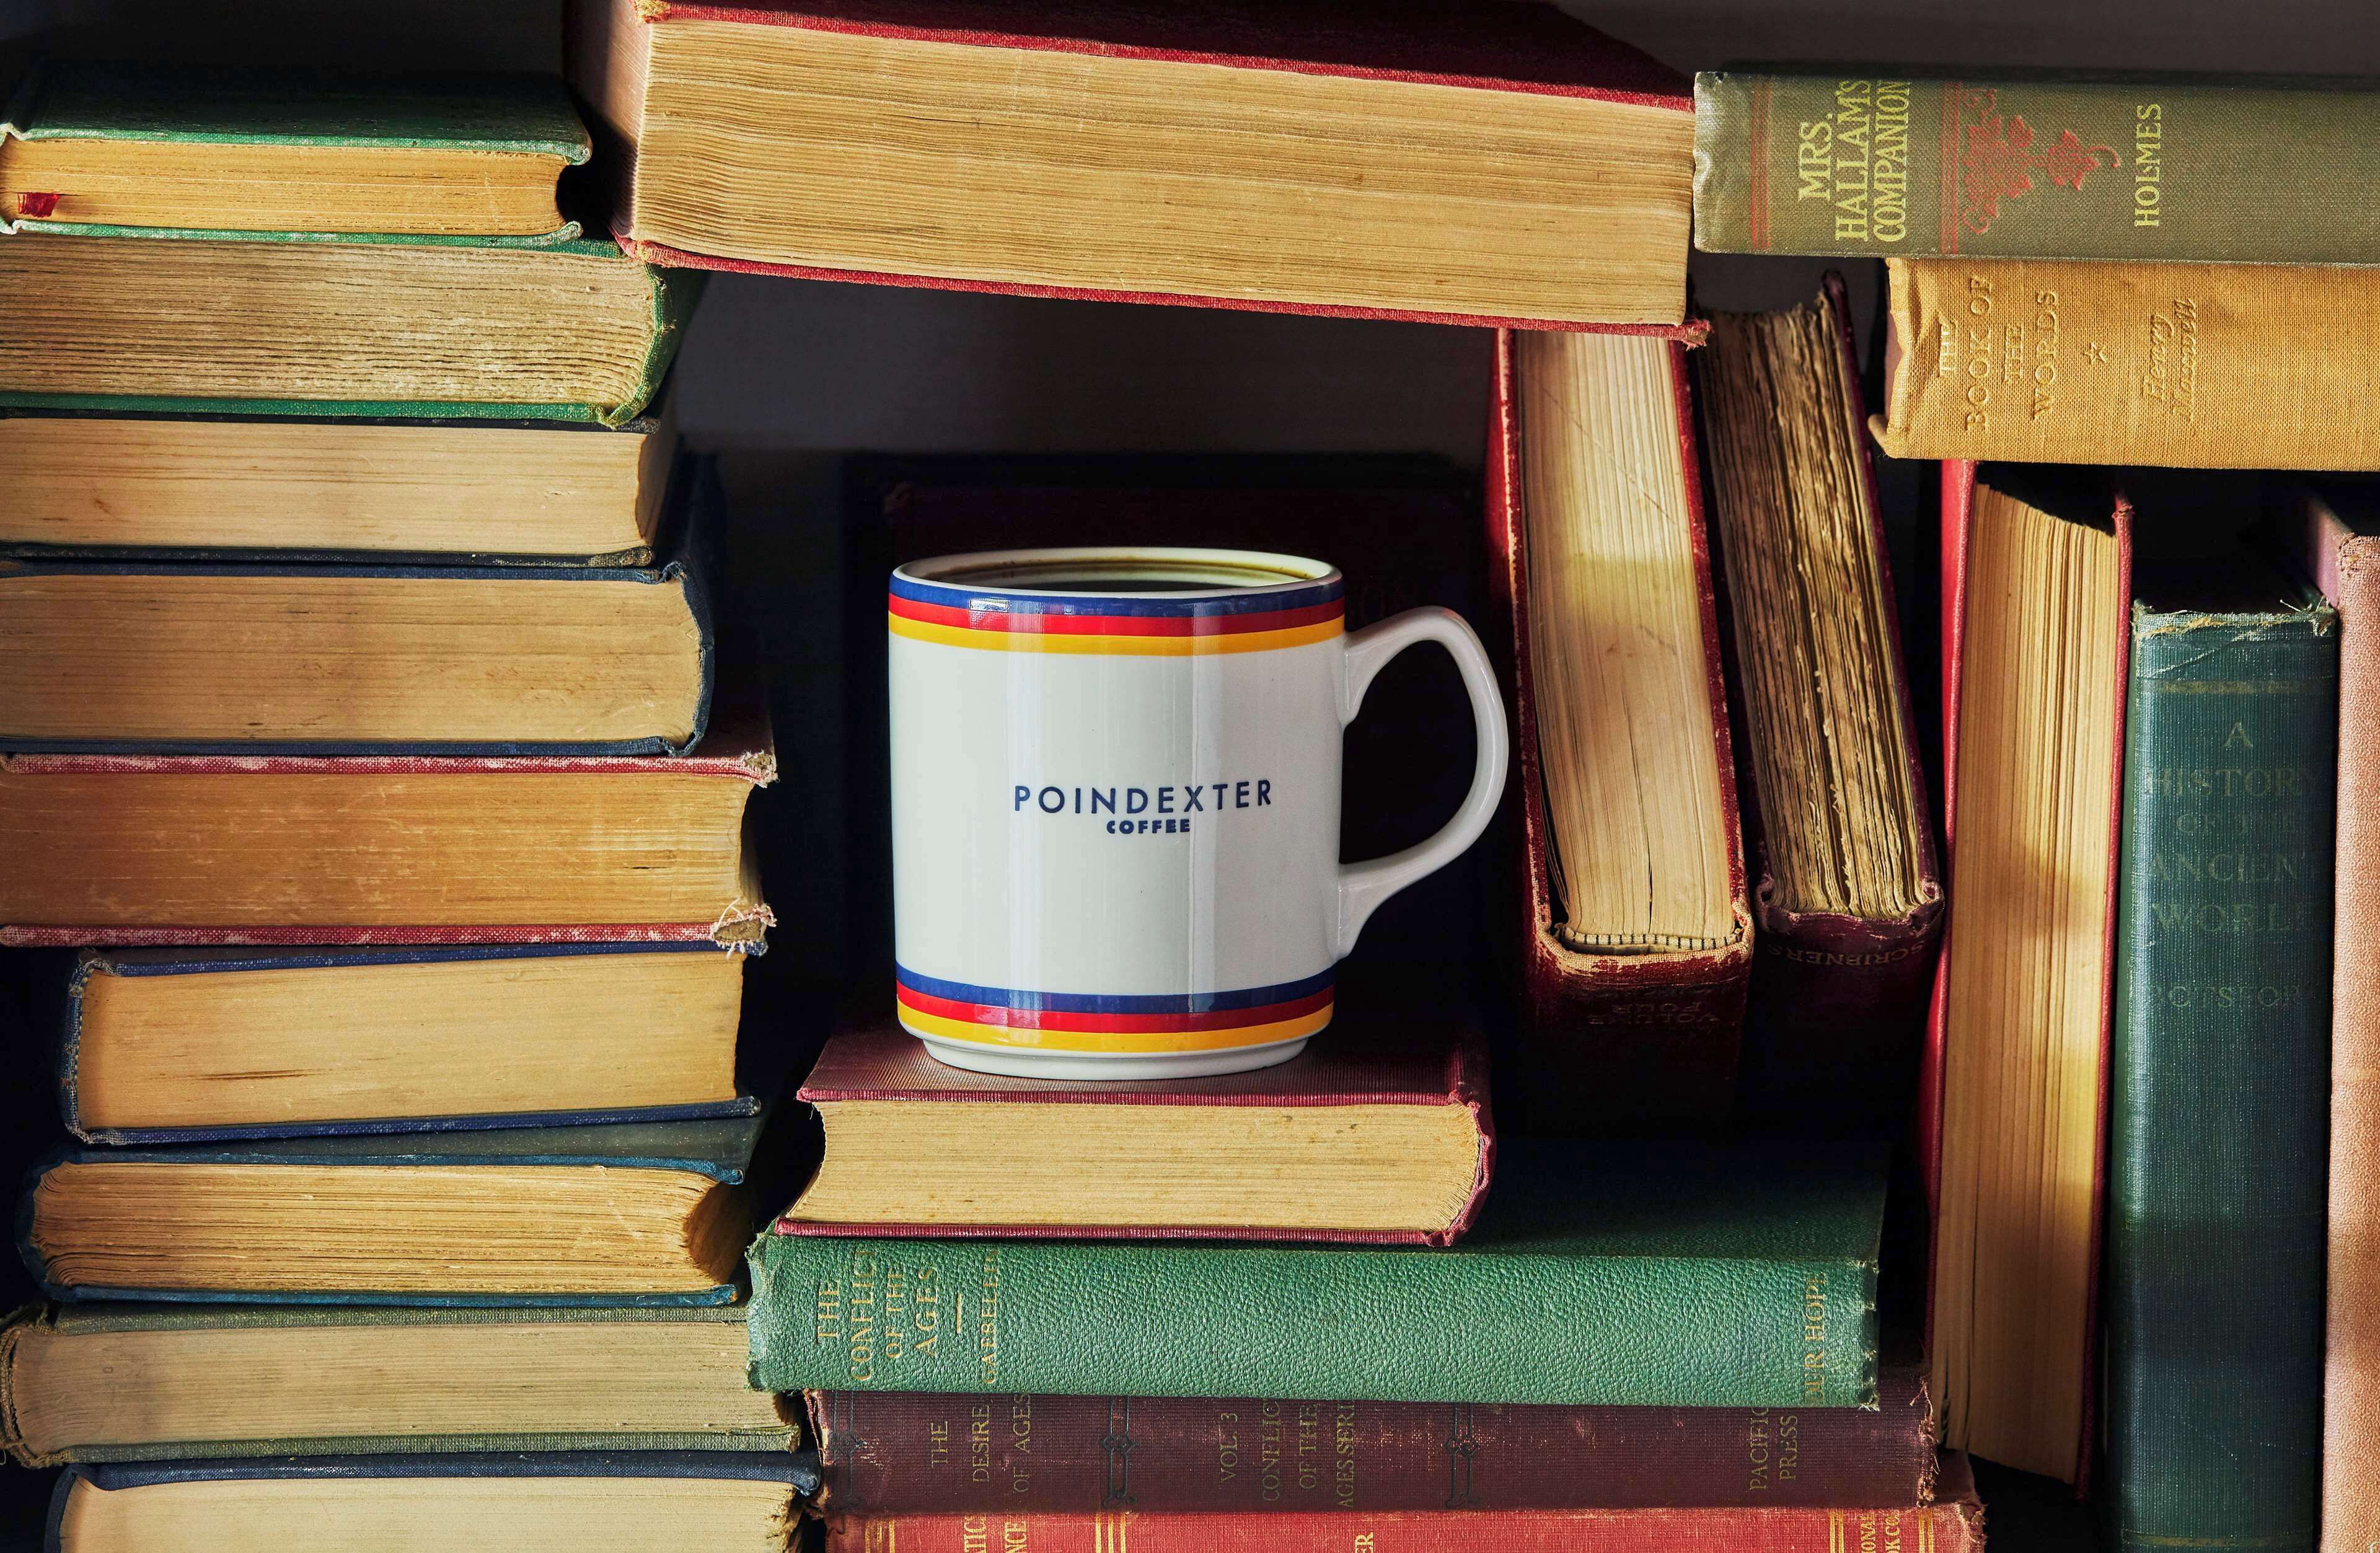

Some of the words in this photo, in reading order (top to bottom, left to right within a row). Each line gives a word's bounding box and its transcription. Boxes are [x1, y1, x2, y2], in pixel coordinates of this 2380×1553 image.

[1798, 112, 1833, 201] MRS.
[1835, 78, 1871, 242] HALLAM'S
[1874, 78, 1911, 244] COMPANION
[2135, 103, 2162, 228] HOLMES
[1970, 276, 1993, 316] OF
[1966, 328, 1992, 433] BOOK
[2004, 324, 2025, 384] THE
[2033, 289, 2058, 421] WORDS
[2141, 313, 2175, 404] Henry
[2173, 298, 2197, 423] Maxwell
[2224, 721, 2254, 749] A
[1014, 779, 1271, 814] POINDEXTER
[1106, 819, 1191, 834] COFFEE
[818, 1279, 840, 1344] THE
[850, 1247, 876, 1381] CONFLICT
[886, 1264, 905, 1313] THE
[915, 1266, 939, 1357] AGES
[1805, 1270, 1827, 1342] HOPE
[885, 1320, 904, 1360] OF
[931, 1420, 950, 1467] THE
[972, 1404, 990, 1483] DESIRE
[1013, 1394, 1031, 1453] AGES
[1221, 1412, 1238, 1423] 3
[1780, 1415, 1798, 1480] PRESS
[1013, 1467, 1031, 1494] OF
[1220, 1430, 1238, 1484] VOL.
[1299, 1464, 1318, 1489] OF
[1338, 1459, 1354, 1508] AGES
